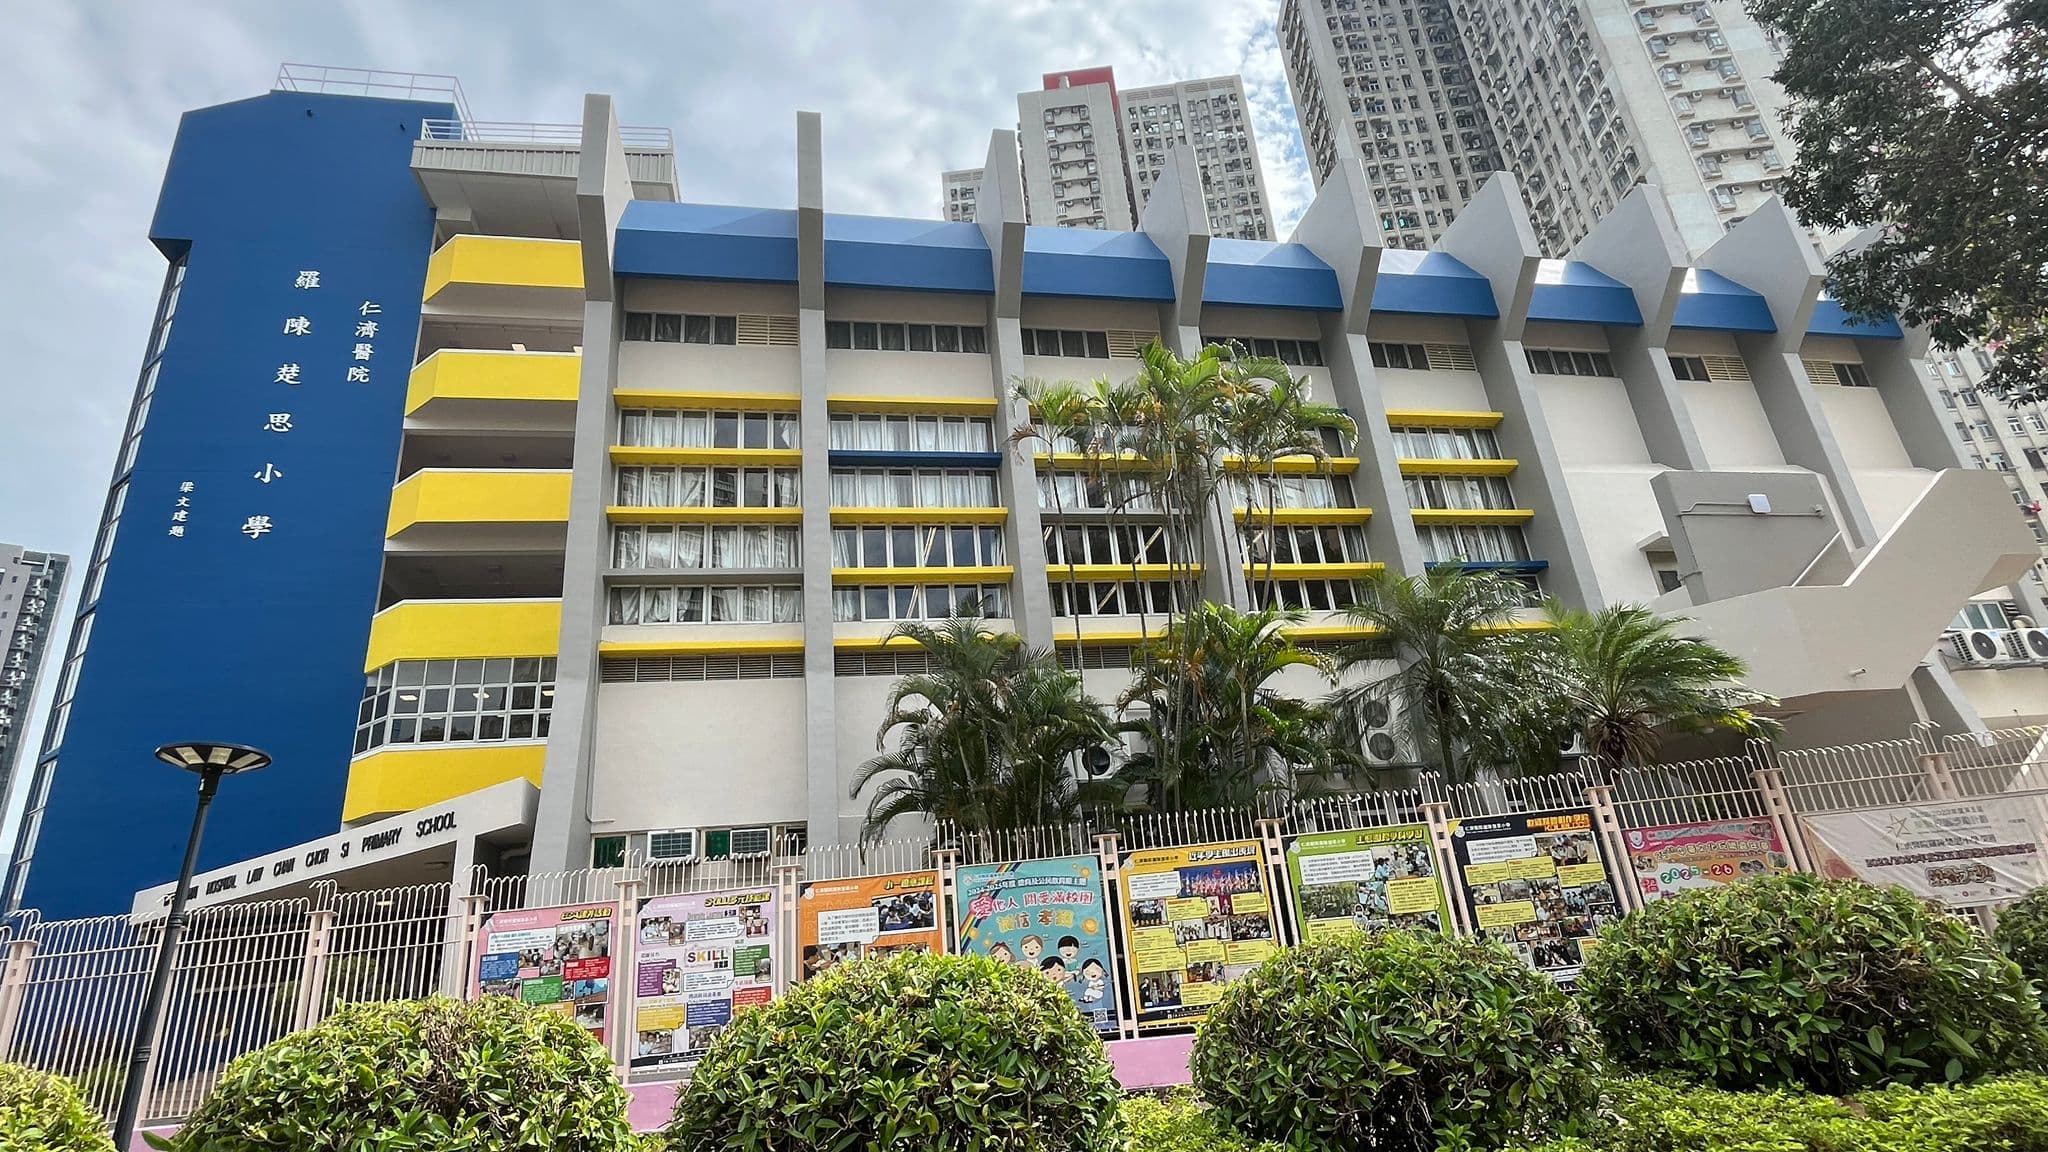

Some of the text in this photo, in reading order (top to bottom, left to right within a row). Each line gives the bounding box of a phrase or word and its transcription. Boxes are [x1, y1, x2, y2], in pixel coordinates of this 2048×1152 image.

[347, 301, 381, 383] 仁濟醫院
[242, 270, 320, 539] 羅陳楚思小學
[306, 848, 329, 867] CHOR
[341, 842, 350, 858] SI
[362, 827, 402, 852] PRIMARY
[416, 812, 457, 838] SCHOOL
[687, 949, 729, 963] SKILL
